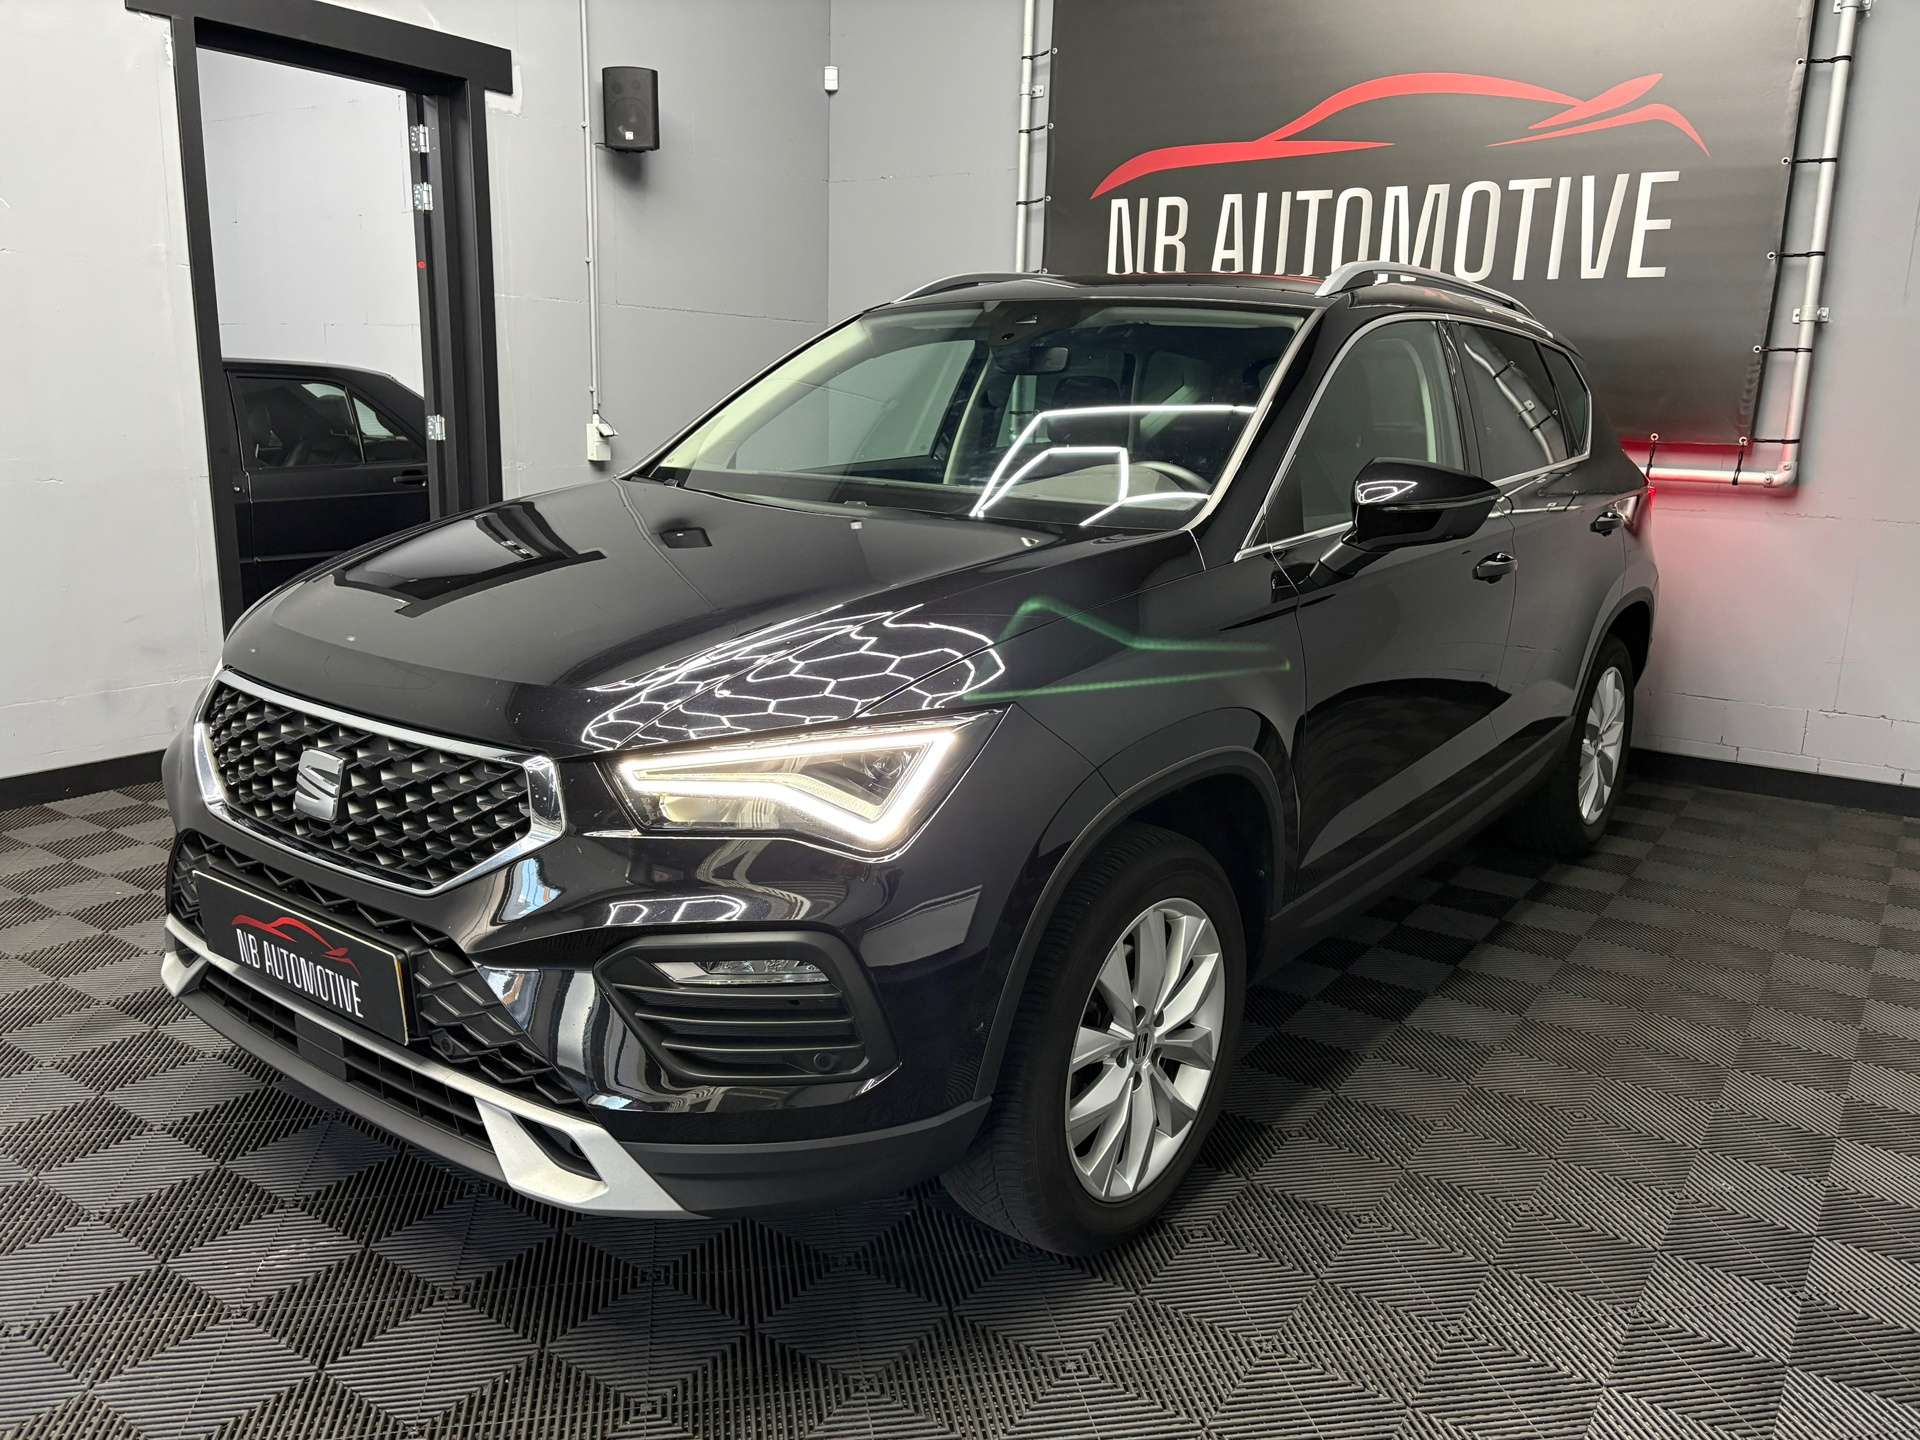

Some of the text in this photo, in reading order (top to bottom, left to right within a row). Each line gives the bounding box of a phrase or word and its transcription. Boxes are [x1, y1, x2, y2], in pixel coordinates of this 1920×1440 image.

[1210, 171, 1681, 284] AUTOMOTIVE
[236, 928, 364, 1019] NB AUTOMOTIVE
